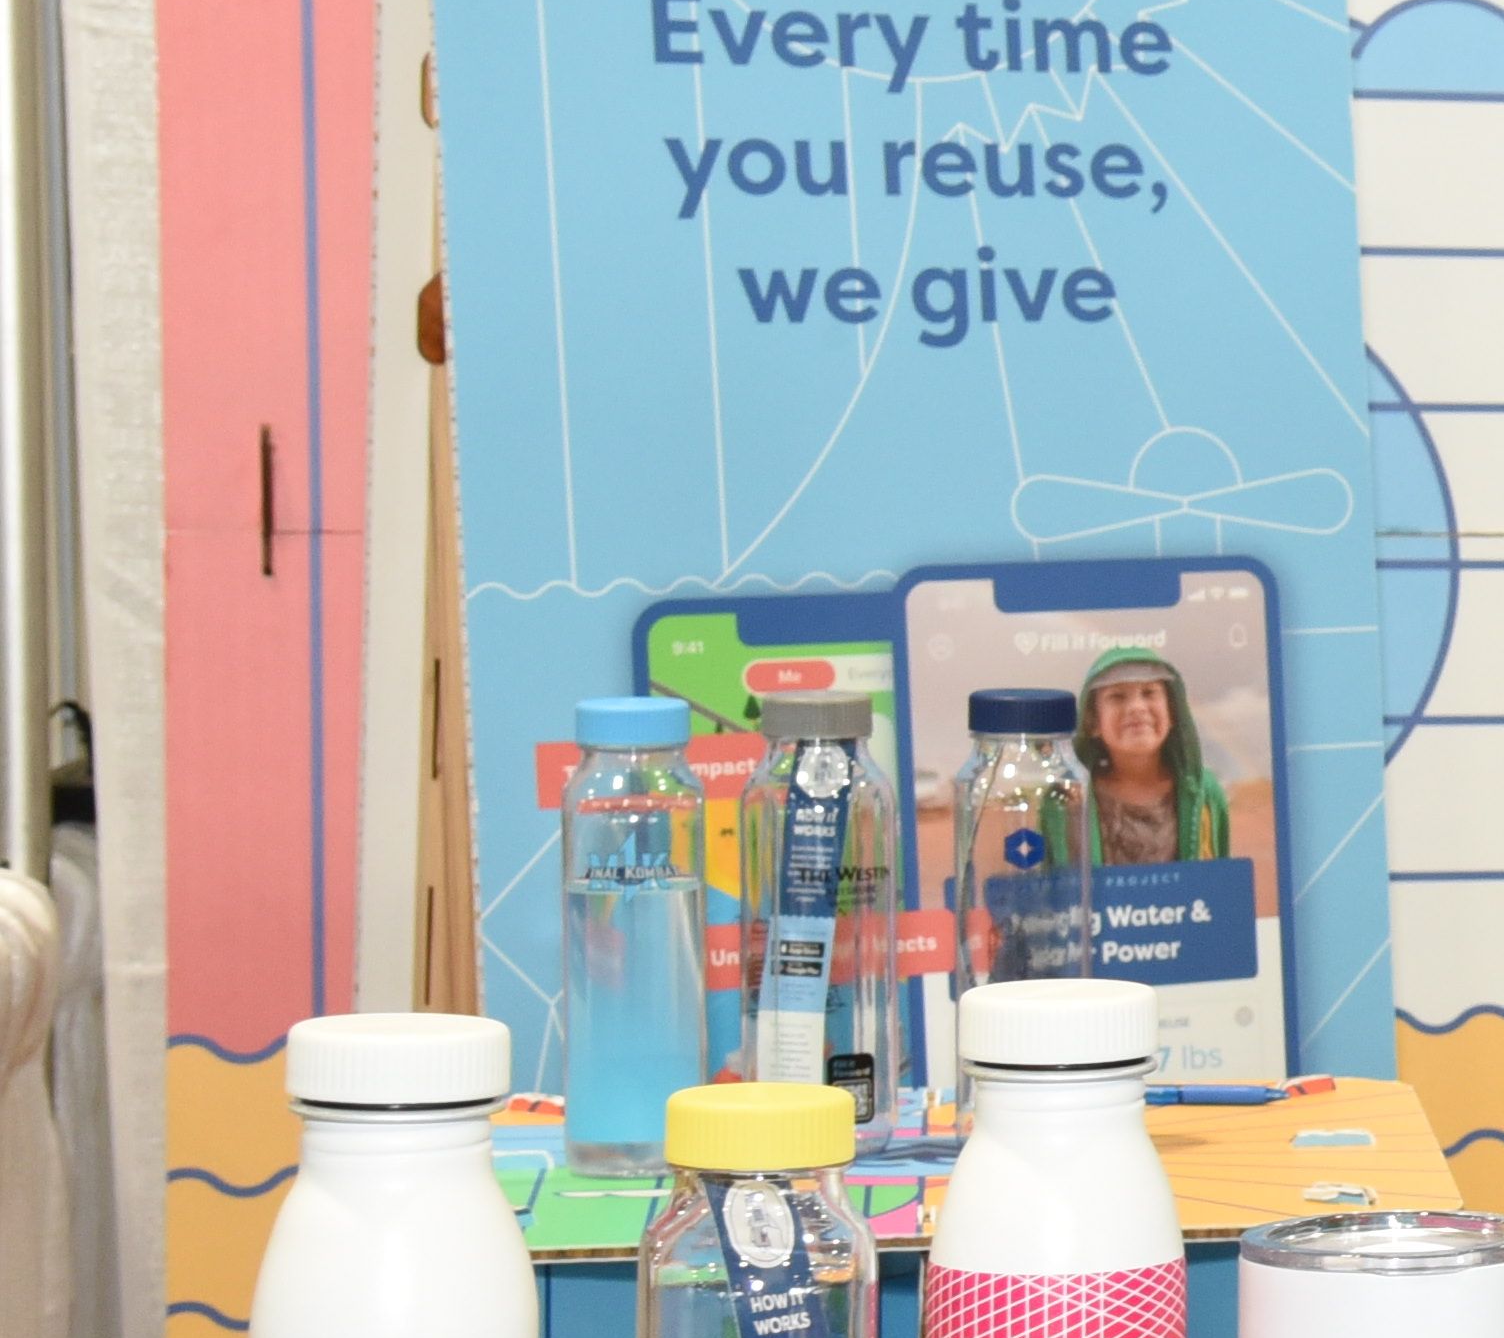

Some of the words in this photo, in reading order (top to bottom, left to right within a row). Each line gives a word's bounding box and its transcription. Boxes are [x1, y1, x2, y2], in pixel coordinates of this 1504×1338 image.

[664, 137, 849, 221] you
[883, 138, 1171, 213] reuse,
[737, 264, 881, 324] we
[910, 246, 1117, 349] give
[1041, 633, 1071, 653] Fill
[1074, 632, 1087, 651] it
[1089, 629, 1167, 649] Forward
[1107, 902, 1186, 929] Water
[1190, 899, 1212, 923] &
[1102, 938, 1182, 965] Power
[1182, 1045, 1223, 1071] lbs
[750, 1293, 787, 1314] HOW
[753, 1311, 812, 1337] WORKS
